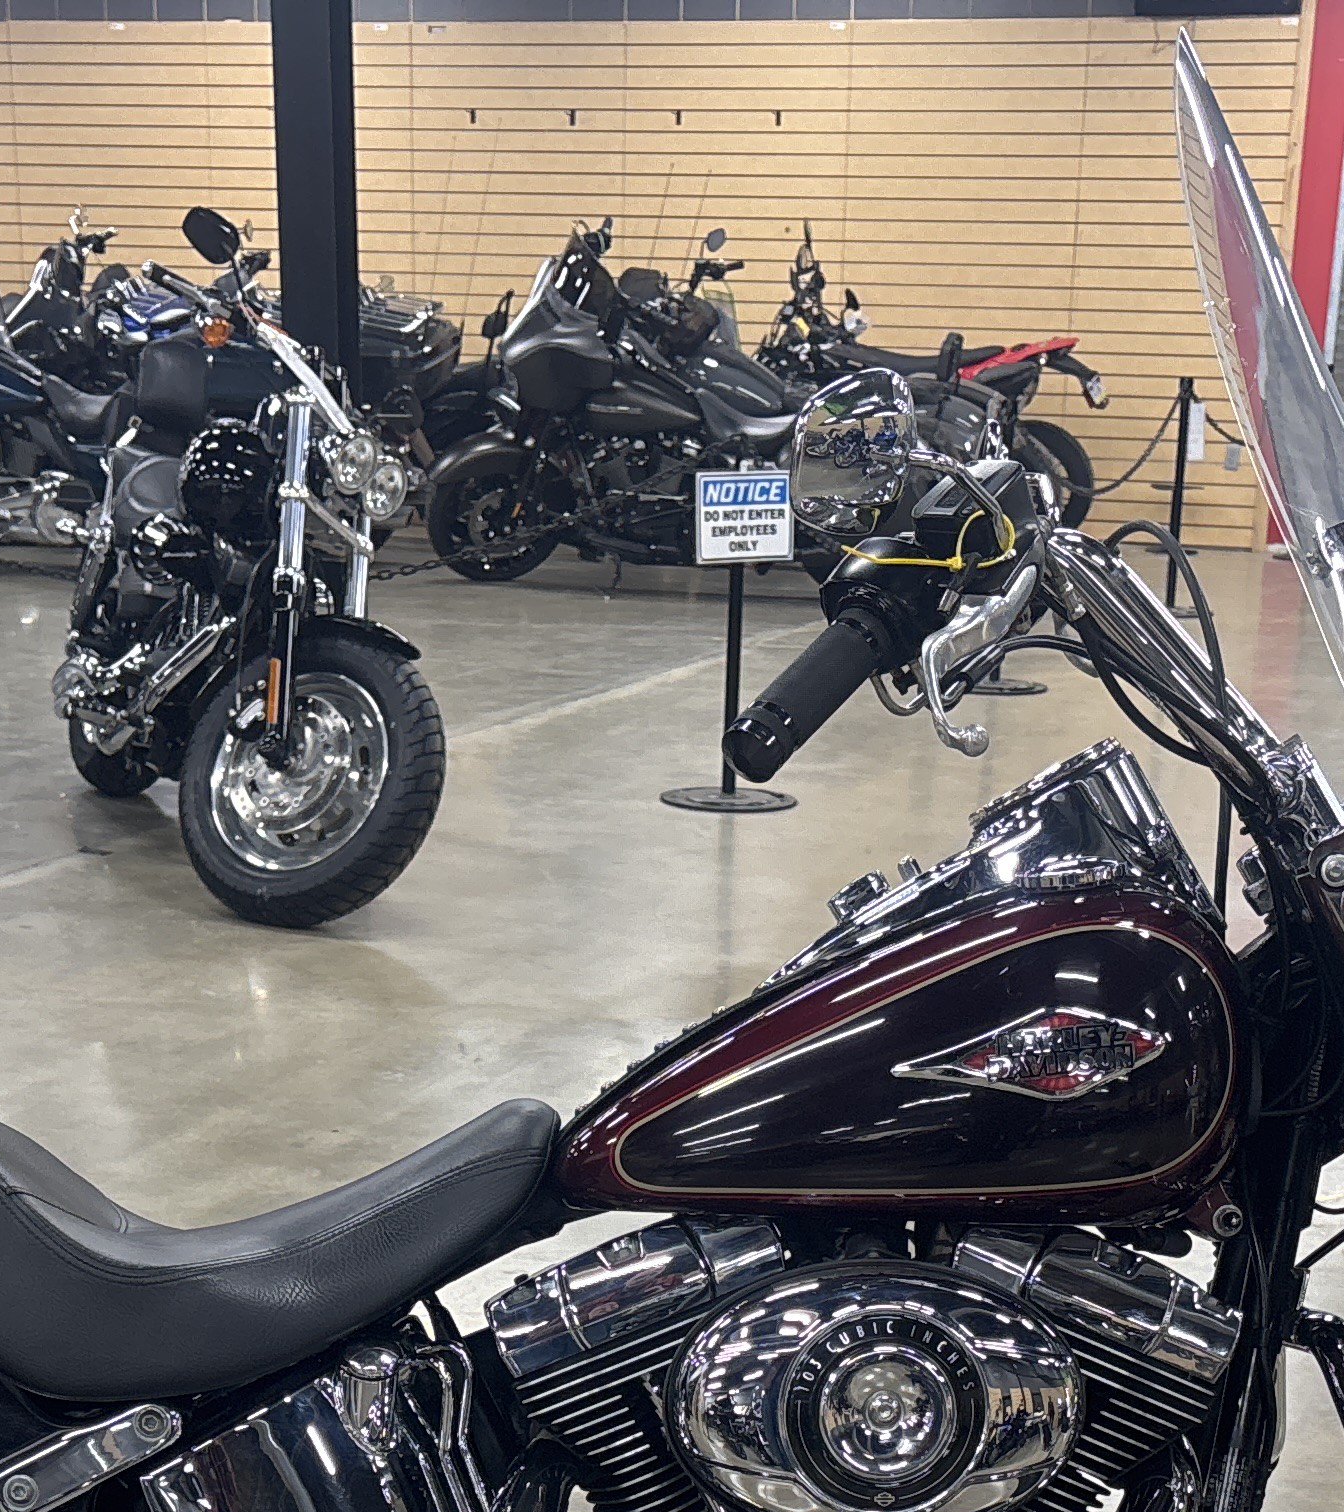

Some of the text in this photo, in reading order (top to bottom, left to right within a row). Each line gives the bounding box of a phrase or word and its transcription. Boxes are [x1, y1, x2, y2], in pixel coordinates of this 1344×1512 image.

[705, 481, 785, 504] NOTICE
[703, 508, 786, 522] DO NOT ENTER
[711, 524, 778, 537] EMPLOYEES
[728, 540, 759, 553] ONLY
[985, 1043, 1135, 1083] DAVIDSON
[792, 1320, 976, 1391] 103 CUBIC INCHES
